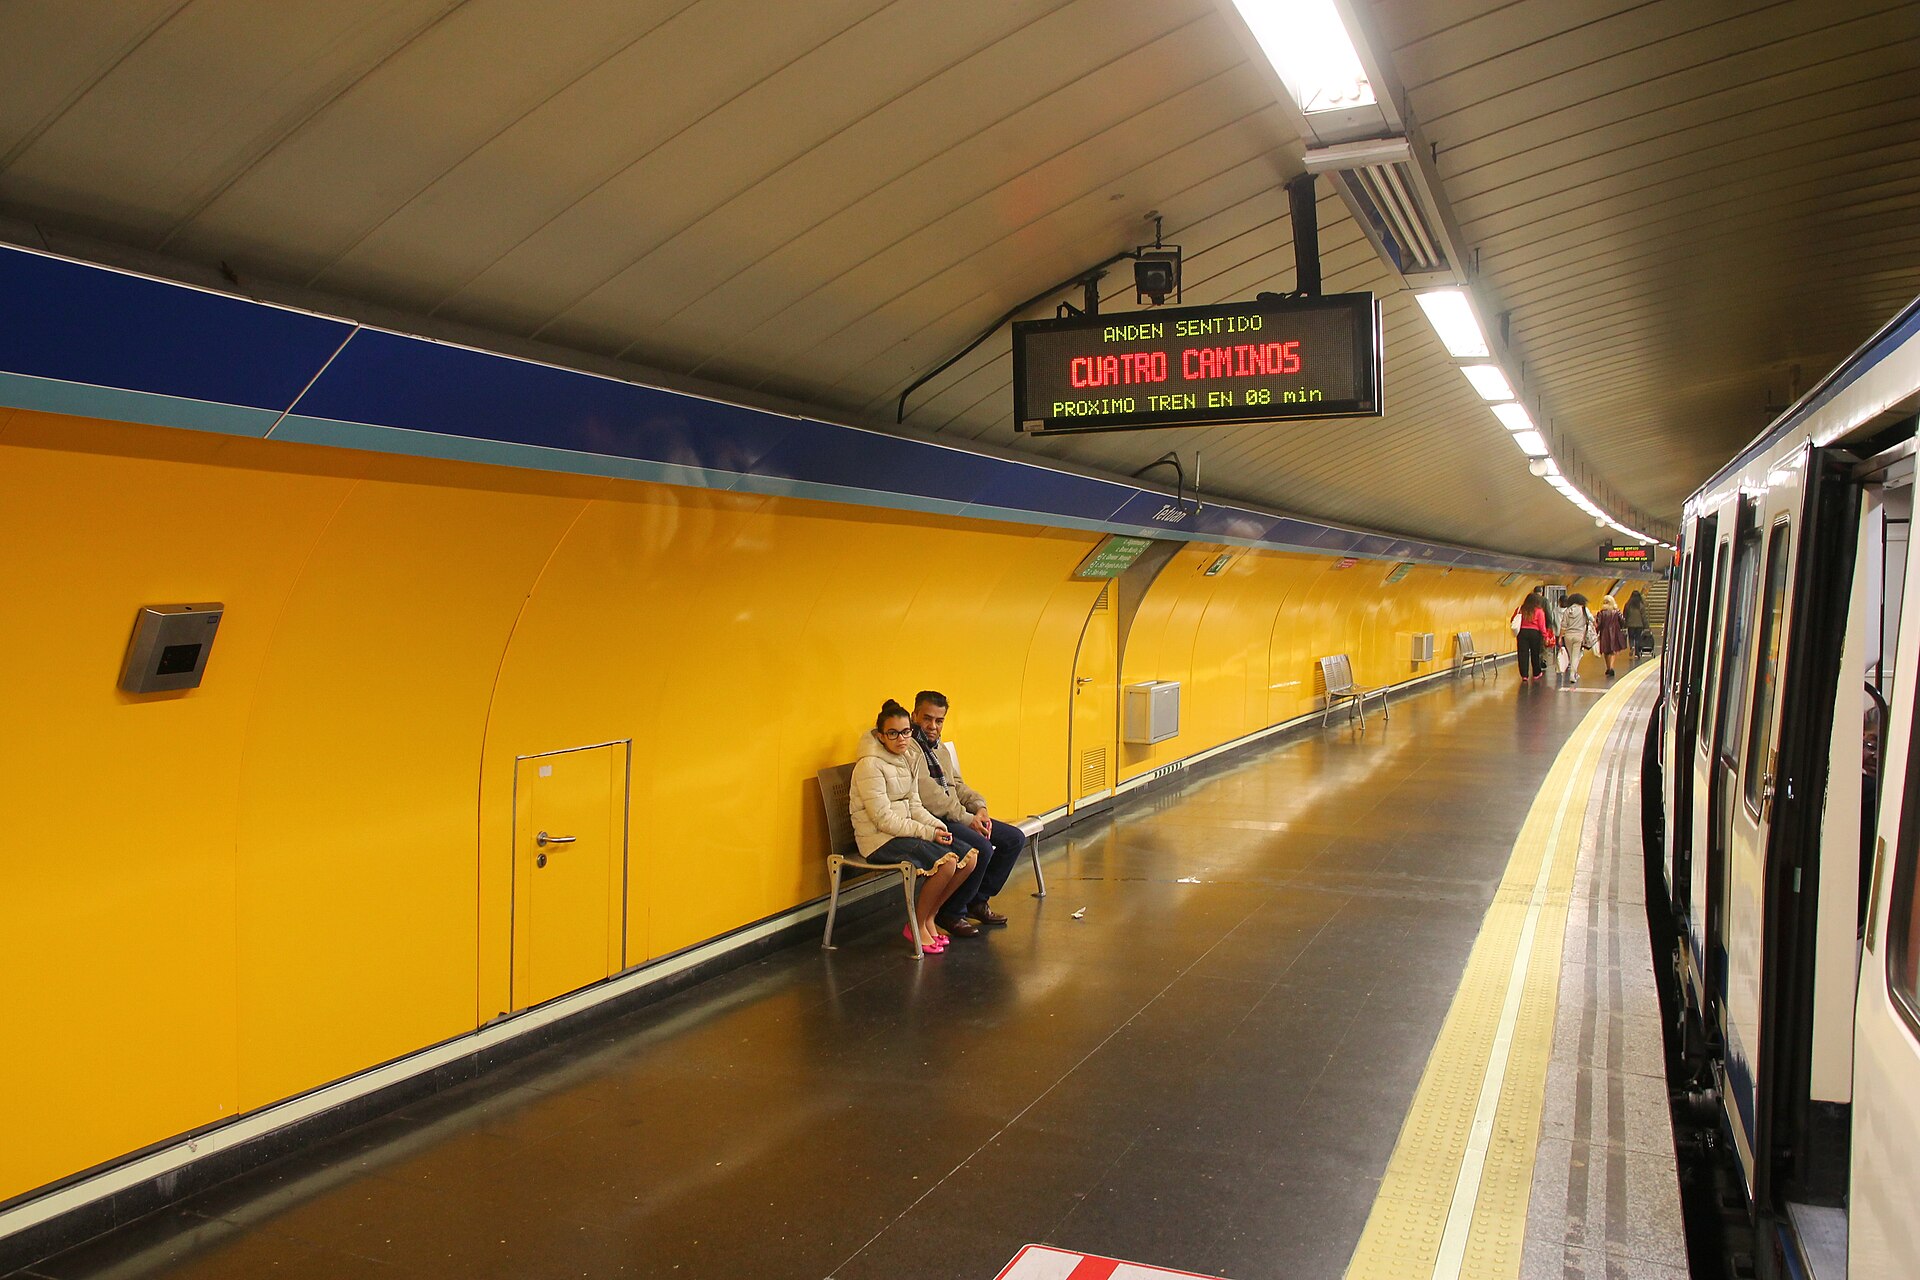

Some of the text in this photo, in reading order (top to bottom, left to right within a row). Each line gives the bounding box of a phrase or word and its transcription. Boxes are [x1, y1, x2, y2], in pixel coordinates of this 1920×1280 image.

[1103, 314, 1263, 343] ANDEN SENTIDO
[1071, 341, 1301, 389] CUATRO CAMINOS
[1053, 386, 1322, 417] PROXIMO TREN EN 08 min
